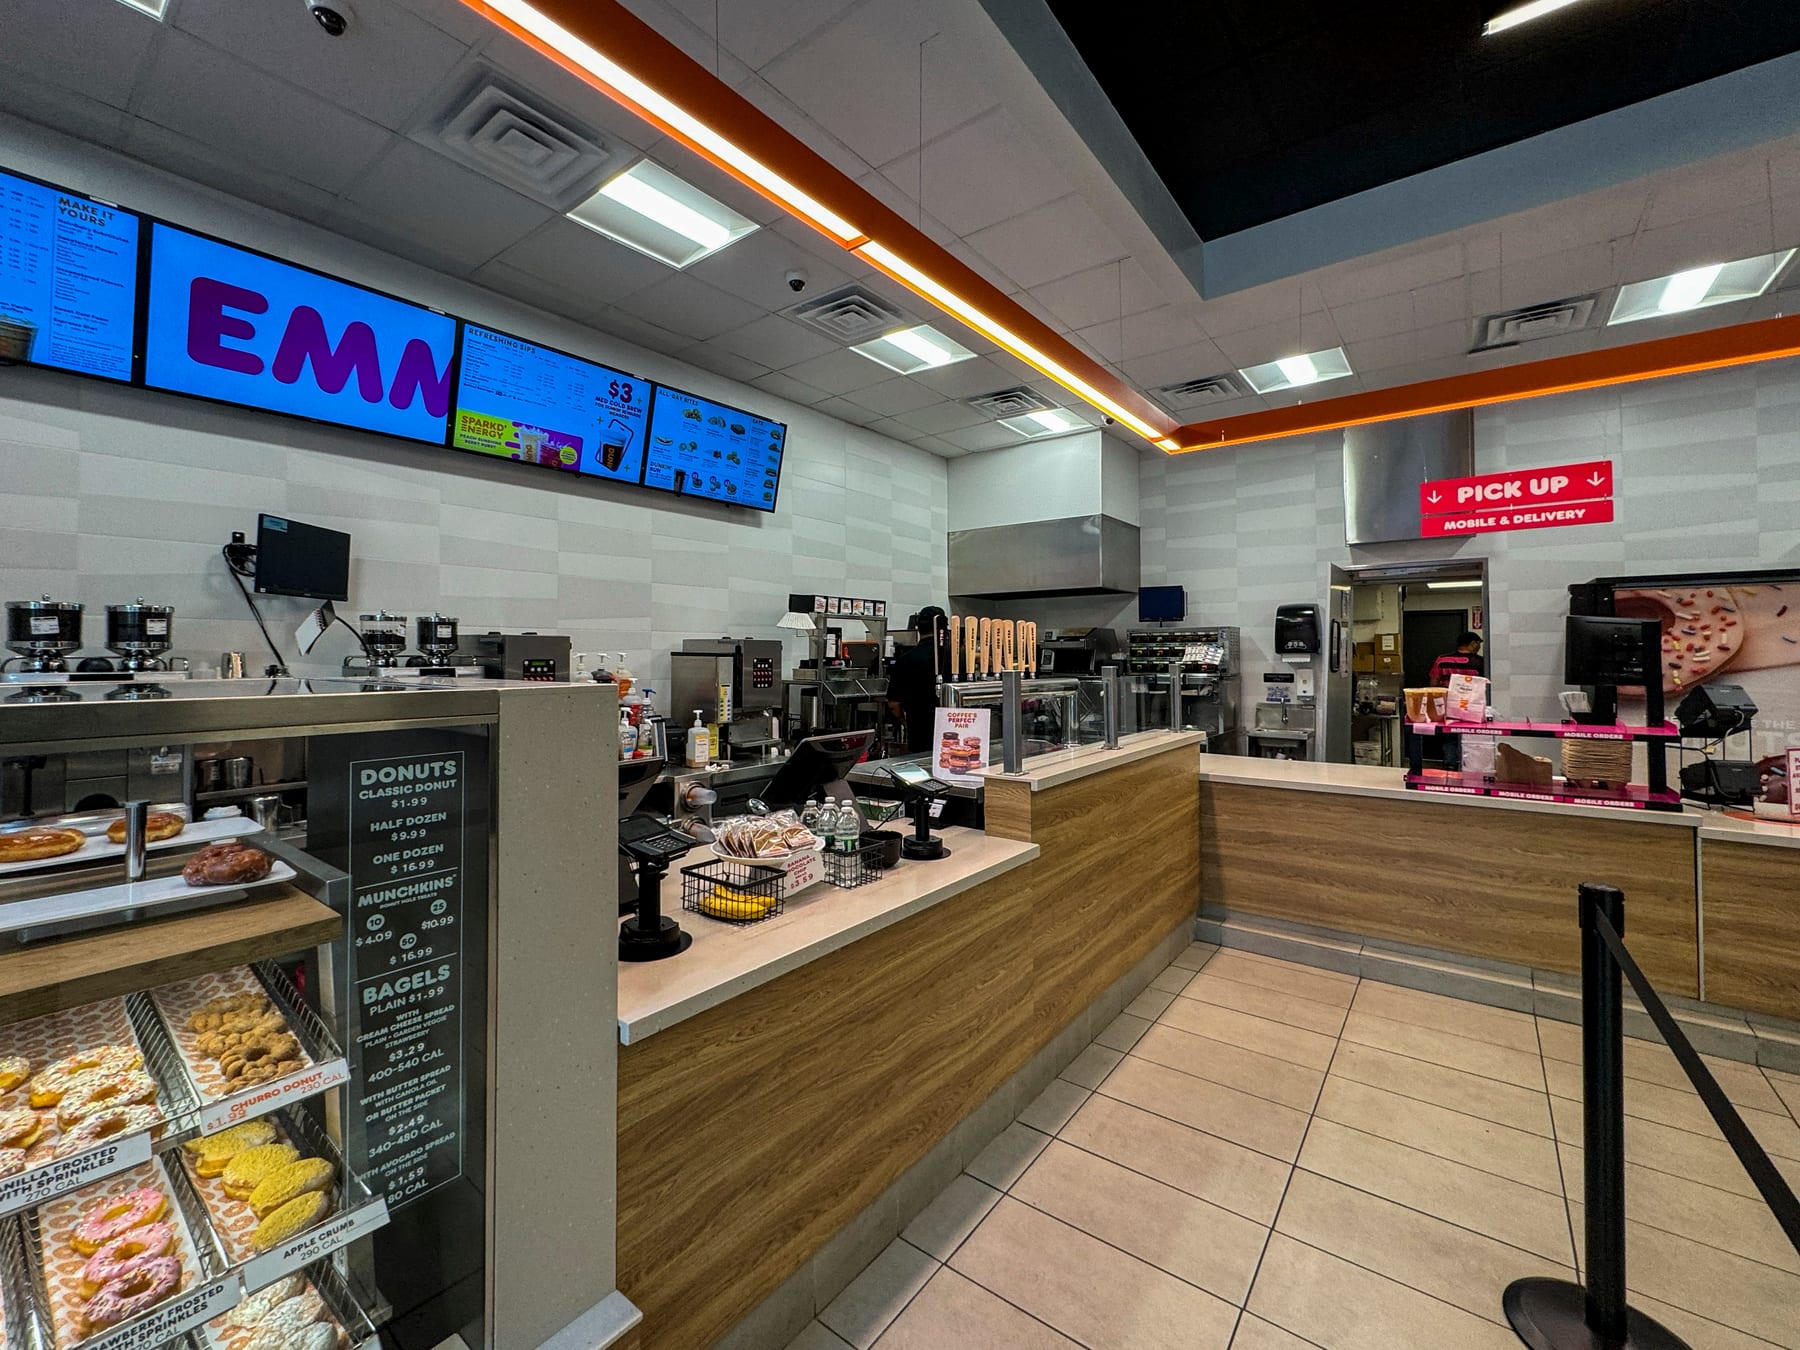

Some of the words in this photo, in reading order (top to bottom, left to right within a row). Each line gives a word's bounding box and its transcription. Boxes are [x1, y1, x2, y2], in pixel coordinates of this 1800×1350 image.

[58, 197, 98, 216] MAKE
[102, 211, 115, 221] IT
[58, 206, 105, 226] YOURS
[468, 328, 518, 349] REFRESHING
[520, 344, 536, 354] SIPS
[608, 379, 633, 404] $3
[595, 396, 608, 404] MED
[610, 400, 626, 409] COLD
[627, 404, 642, 413] BREW
[461, 424, 504, 439] ENERGY
[1457, 481, 1522, 504] PICK
[1530, 476, 1569, 496] UP
[1444, 517, 1496, 531] MOBILE
[1500, 516, 1510, 526] &
[1512, 509, 1586, 524] DELIVERY
[360, 760, 457, 785] DONUTS
[359, 785, 412, 800] CLASSIC
[415, 780, 457, 793] DONUT
[391, 797, 428, 809] $1.99
[370, 819, 402, 832] HALF
[406, 812, 447, 826] DOZEN
[391, 829, 426, 841] $9.99
[373, 851, 400, 864] ONE
[403, 844, 444, 859] DOZEN
[433, 902, 444, 911] 25
[363, 964, 451, 1004] BAGELS
[370, 996, 406, 1016] PLAIN
[396, 1009, 419, 1021] WITH
[356, 1027, 388, 1043] CREAM
[390, 1014, 422, 1032] CHEESE
[424, 1004, 455, 1020] SPREAD
[389, 1042, 425, 1062] $3.29
[368, 1057, 419, 1082] 400-540
[422, 1049, 444, 1063] CAL
[323, 1073, 345, 1085] CAL
[360, 1092, 384, 1106] WITH
[386, 1078, 419, 1096] BUTTER
[420, 1065, 451, 1082] SPREAD
[230, 1088, 281, 1112] CHURRO
[283, 1072, 324, 1093] DONUT
[366, 1114, 379, 1122] OR
[380, 1098, 413, 1117] BUTTER
[415, 1084, 447, 1102] PACKET
[397, 1108, 412, 1117] THE
[421, 1120, 443, 1134] CAL
[54, 1146, 118, 1174] FROSTED
[380, 1148, 424, 1173] AVOCADO
[425, 1131, 456, 1151] SPREAD
[37, 1155, 115, 1189] SPRINKLES
[25, 1187, 51, 1202] 270
[55, 1177, 83, 1191] CAL
[387, 1191, 402, 1204] 80
[406, 1179, 429, 1194] CAL
[283, 1240, 315, 1259] APPLE
[318, 1220, 355, 1242] CRUMB
[300, 1247, 320, 1261] 290
[322, 1237, 342, 1249] CAL
[168, 1285, 224, 1315] FROSTED
[139, 1302, 208, 1341] SPRINKLES
[155, 1328, 180, 1343] CAL
